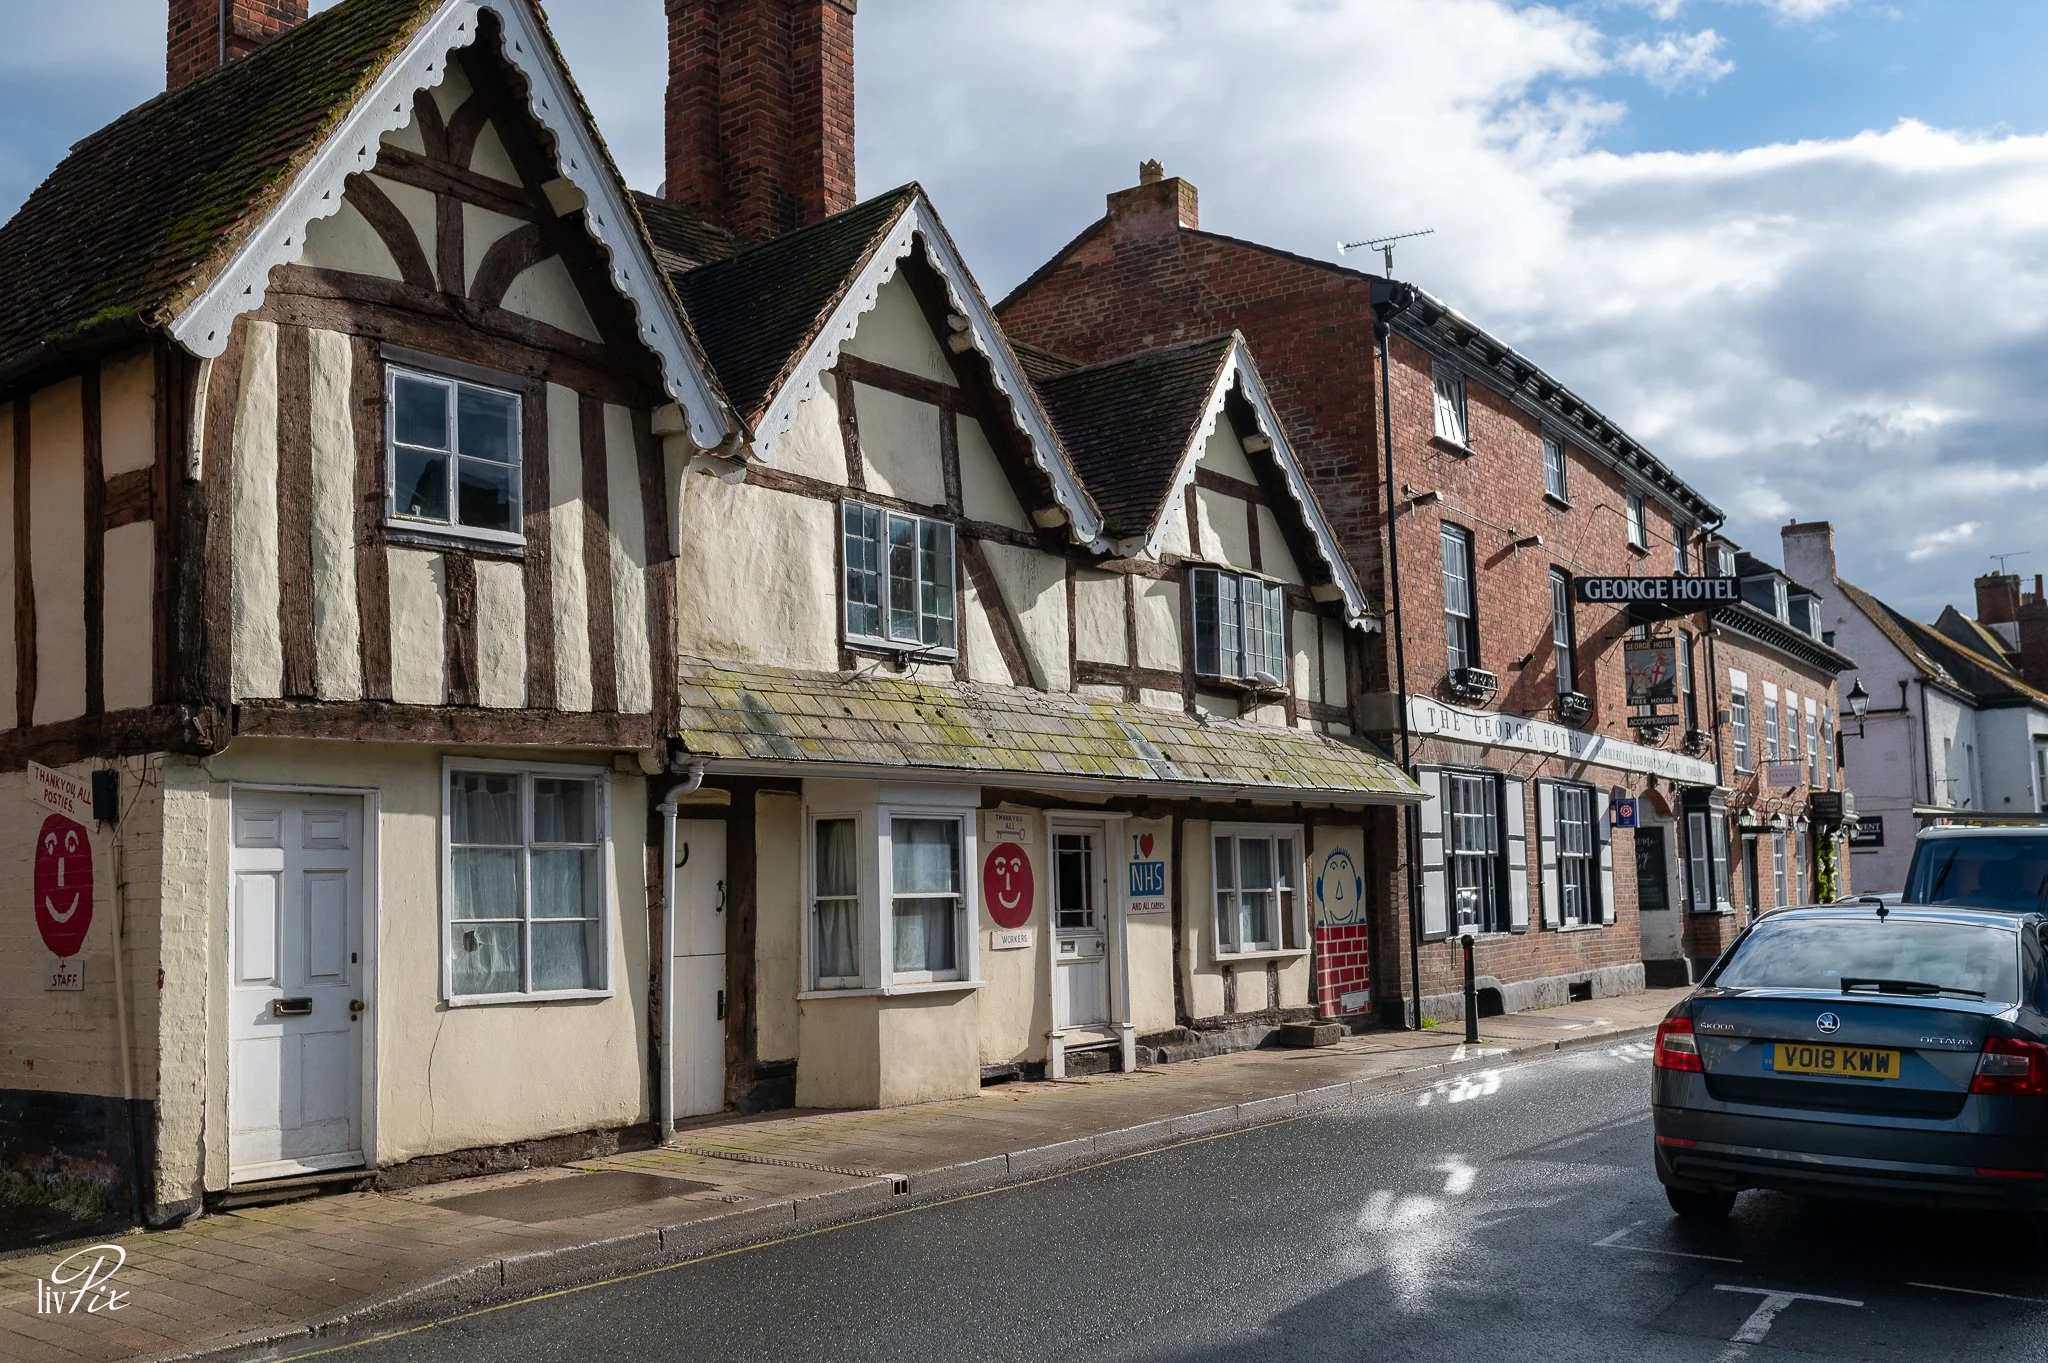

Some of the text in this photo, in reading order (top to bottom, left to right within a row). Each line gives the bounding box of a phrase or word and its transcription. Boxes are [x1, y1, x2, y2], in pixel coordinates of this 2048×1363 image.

[1584, 579, 1738, 600] GEORGE HOTEL
[1625, 641, 1674, 651] GEORGE HOTEL
[1427, 707, 1582, 754] THE GEORGE HOTEL
[1628, 716, 1679, 726] ACCOMMODATION
[44, 788, 75, 814] POSTIES.
[77, 787, 92, 806] ALL
[1005, 822, 1016, 830] ALL
[1132, 834, 1140, 860] I
[1131, 863, 1163, 892] NHS
[1131, 902, 1142, 911] AND
[1143, 901, 1151, 910] ALL
[51, 973, 78, 988] STAFF.
[1920, 1036, 1973, 1046] OCTAVIA
[1784, 1046, 1836, 1069] VO18
[1842, 1050, 1890, 1074] KWW
